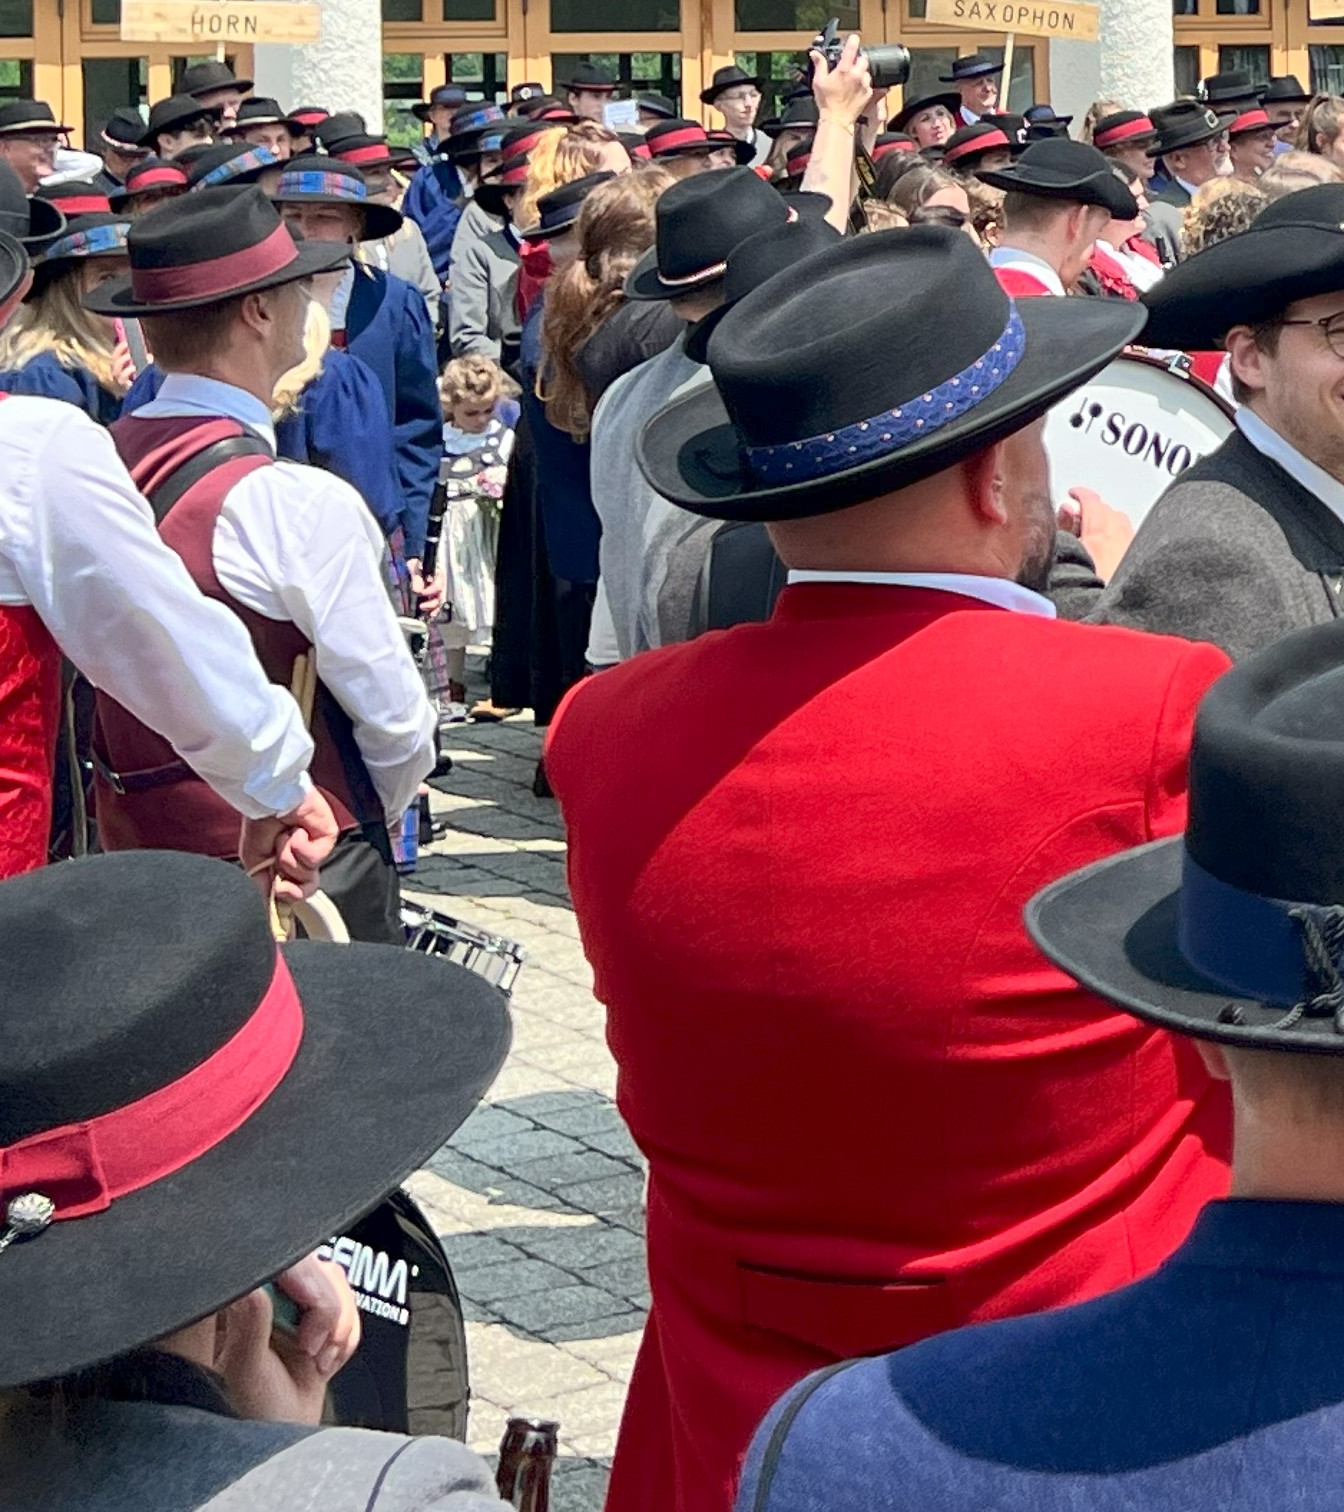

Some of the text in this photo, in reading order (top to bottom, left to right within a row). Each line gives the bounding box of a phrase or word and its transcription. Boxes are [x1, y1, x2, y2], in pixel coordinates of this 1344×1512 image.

[191, 13, 258, 34] HORN
[953, 0, 1076, 31] SAXOPHON
[1100, 411, 1195, 477] SONO
